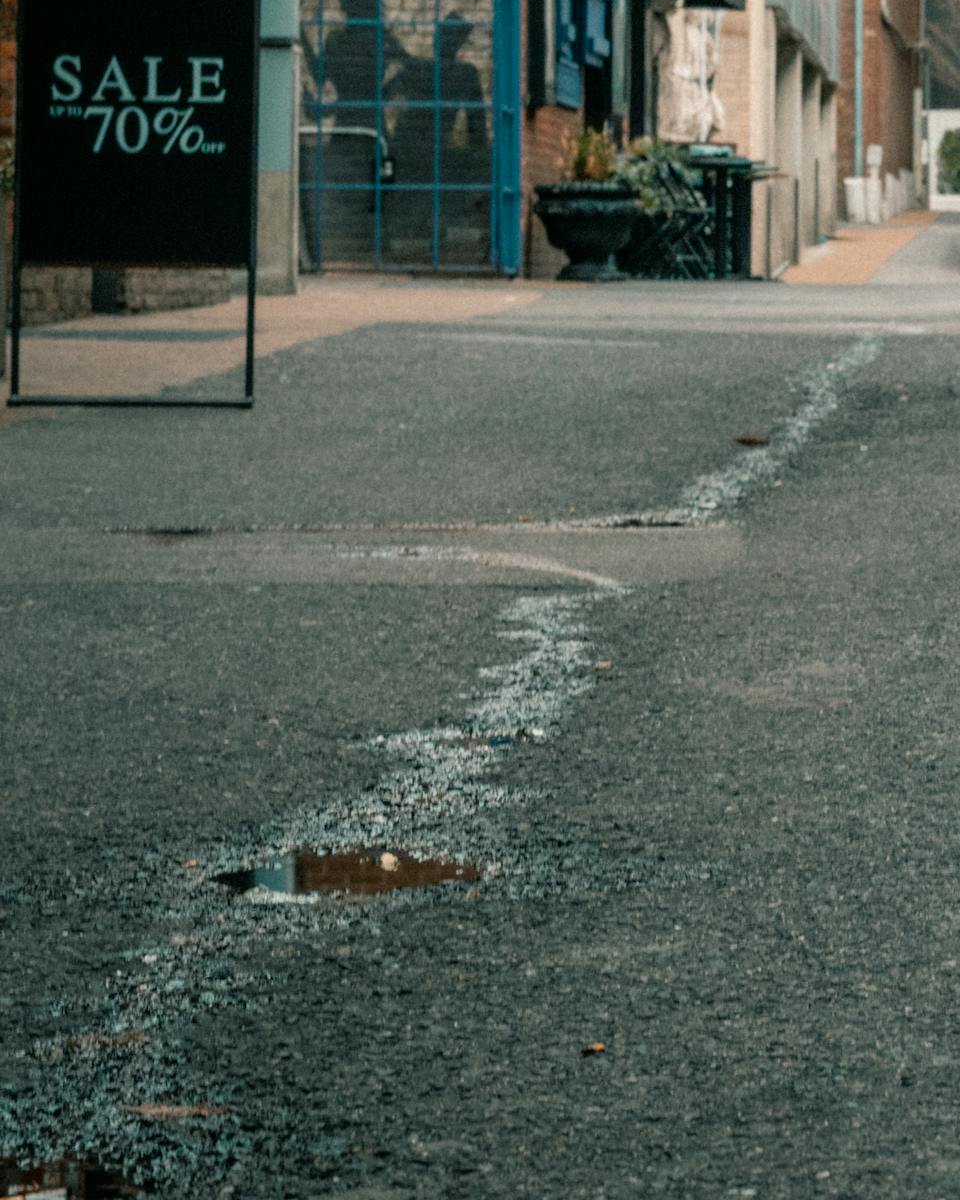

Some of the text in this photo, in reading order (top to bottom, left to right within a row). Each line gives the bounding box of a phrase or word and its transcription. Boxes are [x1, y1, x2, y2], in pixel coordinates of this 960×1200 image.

[51, 54, 226, 103] SALE
[49, 105, 65, 118] UP
[83, 105, 205, 154] 70%
[201, 142, 226, 154] OFF
